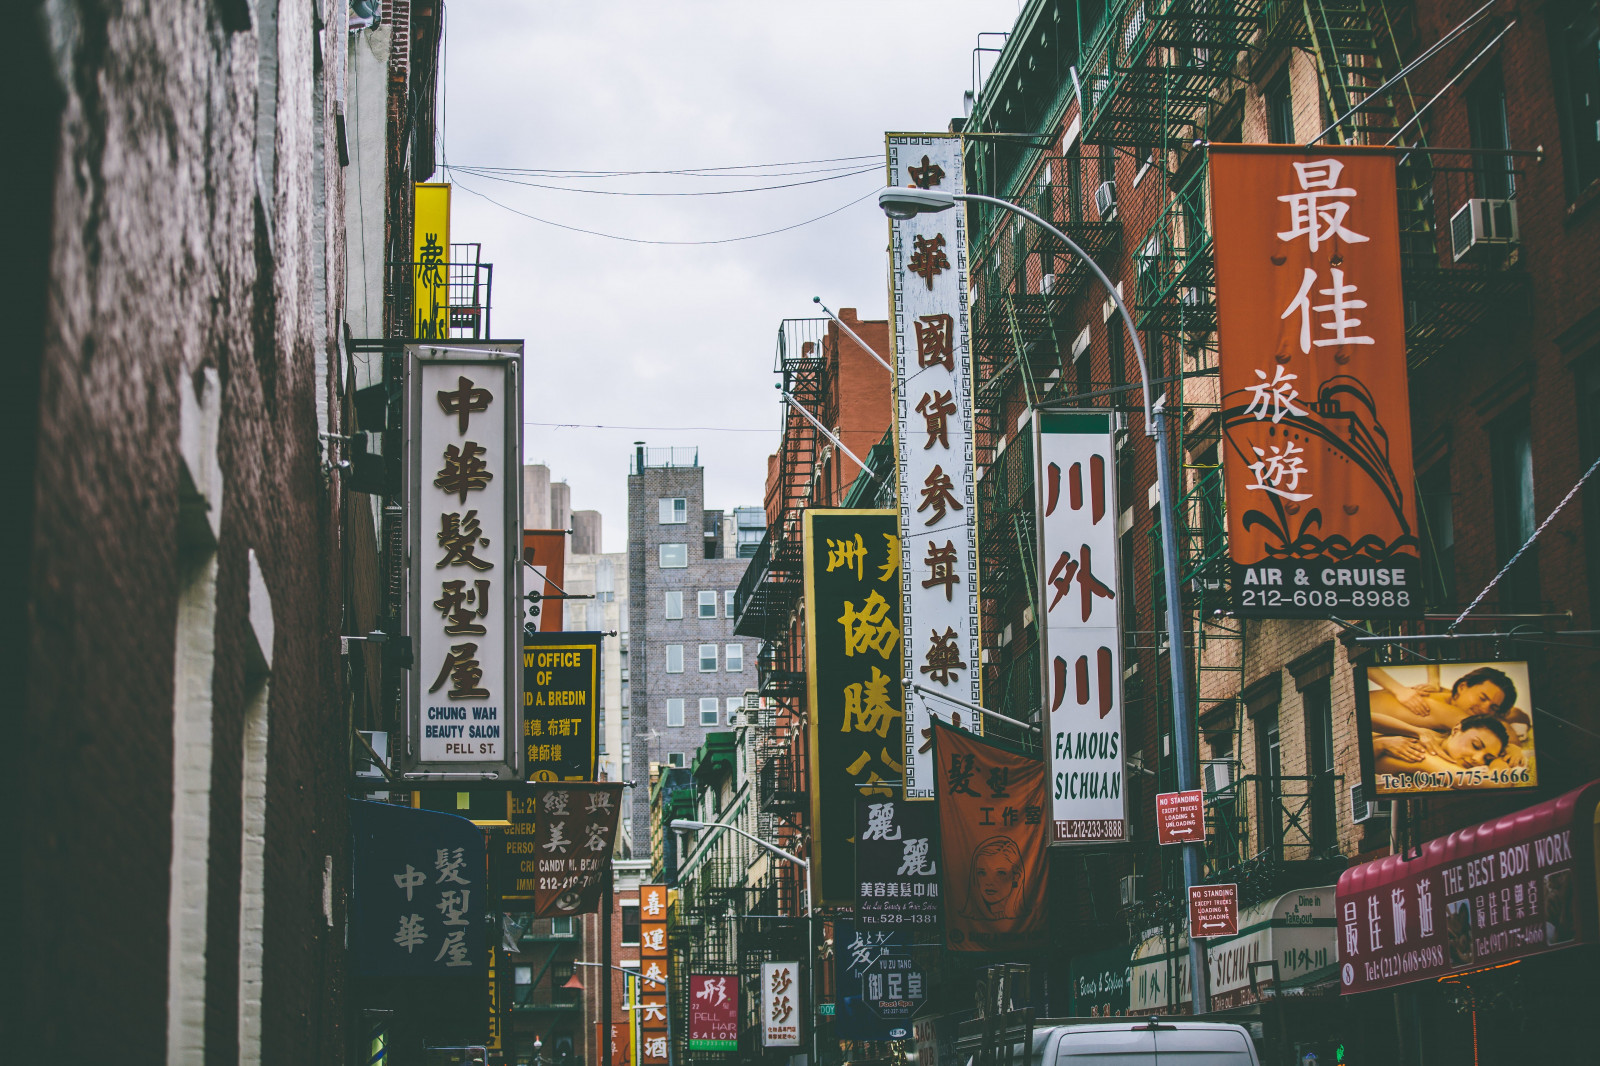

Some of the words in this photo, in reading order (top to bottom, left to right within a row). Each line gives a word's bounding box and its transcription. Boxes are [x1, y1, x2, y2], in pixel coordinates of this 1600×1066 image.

[1277, 158, 1375, 355] 最佳
[1244, 365, 1313, 501] 旅遊
[428, 376, 494, 699] 中華髮型屋
[1243, 568, 1283, 586] AIR
[1294, 568, 1310, 586] &
[1321, 568, 1407, 586] CRUISE
[1046, 454, 1116, 720] 川外川
[1242, 590, 1410, 607] 212-608-8988
[538, 652, 581, 667] OFFICE
[536, 671, 552, 686] OF
[535, 692, 546, 706] A.
[548, 690, 586, 706] BREDIN
[428, 706, 467, 720] CHUNG
[472, 706, 497, 720] WAH
[425, 725, 464, 738] BEAUTY
[468, 725, 500, 738] SALON
[547, 717, 582, 736] 布瑞丁
[446, 743, 474, 754] PELL
[479, 743, 496, 754] ST.
[527, 744, 562, 762] 律師樓
[1055, 731, 1119, 760] FAMOUS
[948, 753, 1010, 798] 髮型
[1055, 771, 1120, 800] SICHUAN
[1160, 798, 1168, 806] NO
[1170, 795, 1200, 804] STANDING
[979, 805, 1041, 827] 工作室
[1165, 820, 1196, 828] UNLOADING
[541, 821, 609, 854] 美容
[1056, 820, 1123, 838] TEL:212-233-3888
[862, 802, 936, 876] 麗麗
[539, 859, 565, 872] CANDY
[1442, 865, 1464, 896] THE
[1469, 854, 1495, 889] BEST
[1499, 842, 1530, 879] BODY
[1534, 830, 1572, 868] WORK
[861, 882, 939, 897] 美容美髮中心
[1192, 891, 1201, 899] NO
[1204, 890, 1234, 898] STANDING
[394, 864, 428, 954] 中華
[434, 847, 472, 966] 髮型屋
[1299, 896, 1313, 906] Dine
[1315, 895, 1321, 906] in
[1198, 906, 1222, 914] LOADING
[1198, 913, 1230, 921] UNLOADING
[880, 960, 888, 969] YU
[889, 960, 896, 969] ZU
[897, 960, 911, 969] TANG
[1284, 947, 1327, 971] 川外川
[868, 972, 922, 1000] 御足堂
[694, 1012, 720, 1025] PELL
[712, 1022, 737, 1031] HAIR
[692, 1031, 737, 1040] SALON
